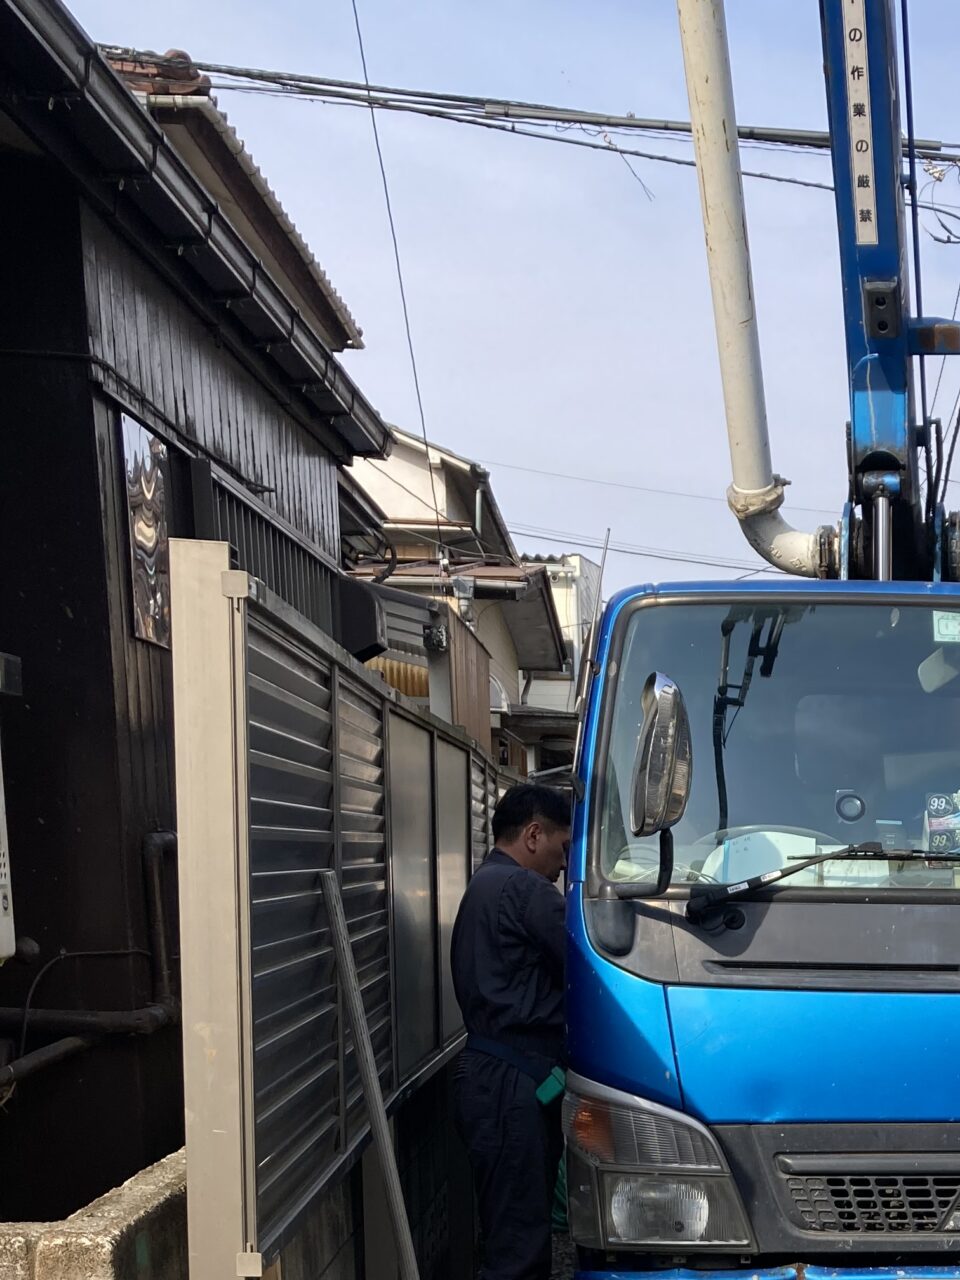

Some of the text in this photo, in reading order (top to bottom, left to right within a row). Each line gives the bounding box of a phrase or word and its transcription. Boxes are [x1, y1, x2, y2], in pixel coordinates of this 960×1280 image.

[849, 0, 872, 222] の作業の厳禁
